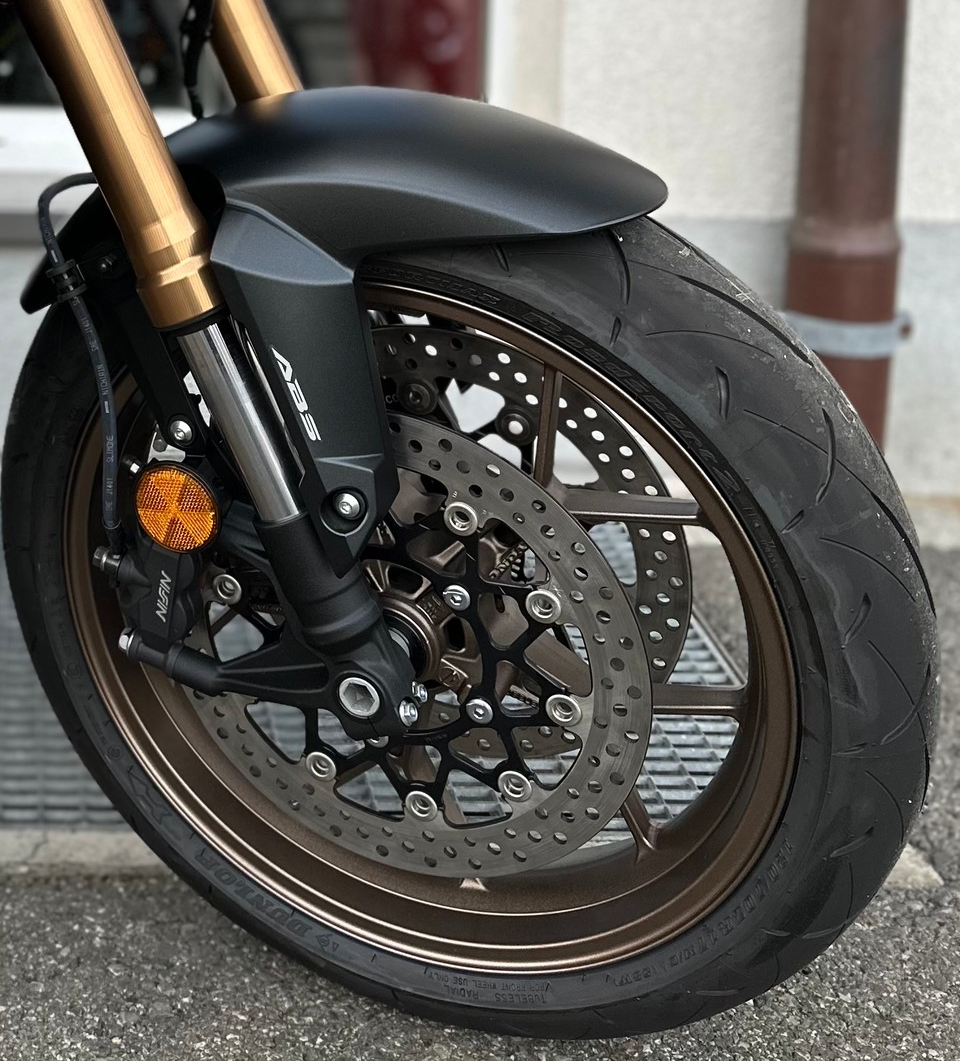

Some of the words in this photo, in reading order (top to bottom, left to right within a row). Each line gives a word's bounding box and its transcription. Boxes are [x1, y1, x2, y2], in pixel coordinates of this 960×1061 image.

[271, 346, 322, 441] ABS
[193, 848, 313, 938] DUNLOP
[452, 976, 468, 987] USE
[443, 984, 479, 1000] RADIAL
[494, 992, 547, 1004] TUBELESS
